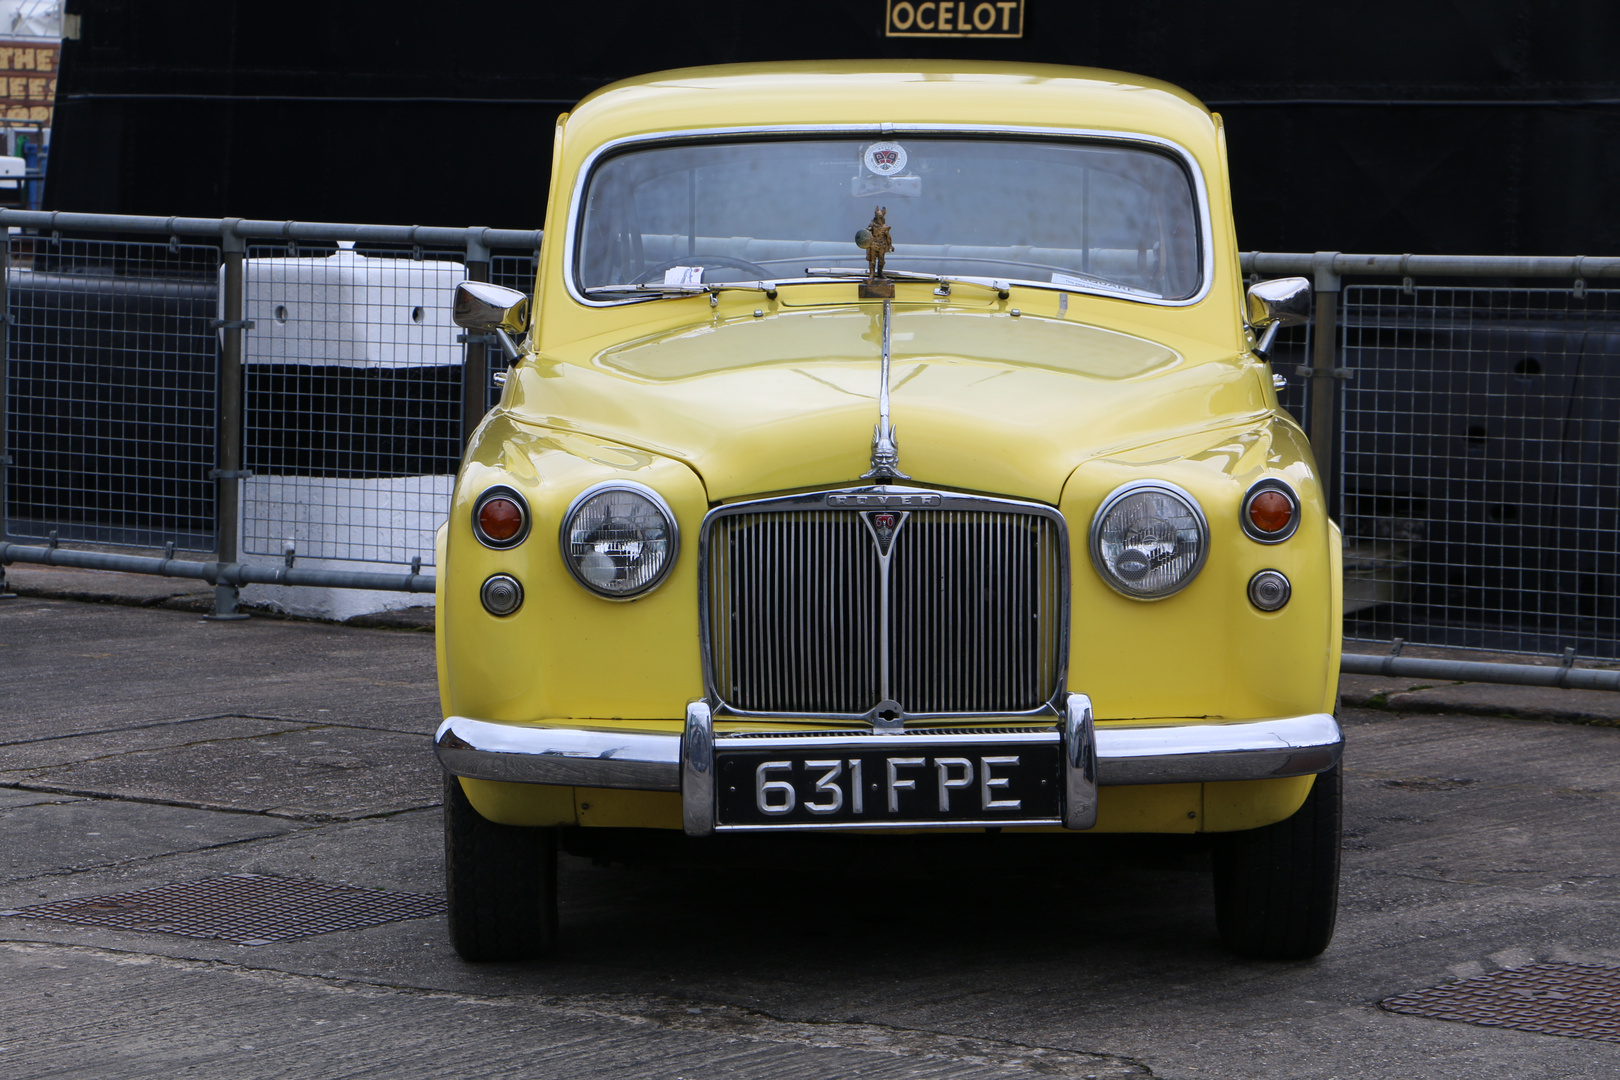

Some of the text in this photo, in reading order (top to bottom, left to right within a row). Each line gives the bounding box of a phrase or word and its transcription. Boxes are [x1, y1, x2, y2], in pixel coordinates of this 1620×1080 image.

[892, 2, 1017, 31] OCELOT
[0, 47, 54, 71] THE
[836, 496, 931, 505] ROVER
[875, 516, 894, 527] 60
[755, 757, 1022, 815] 631 FPE
